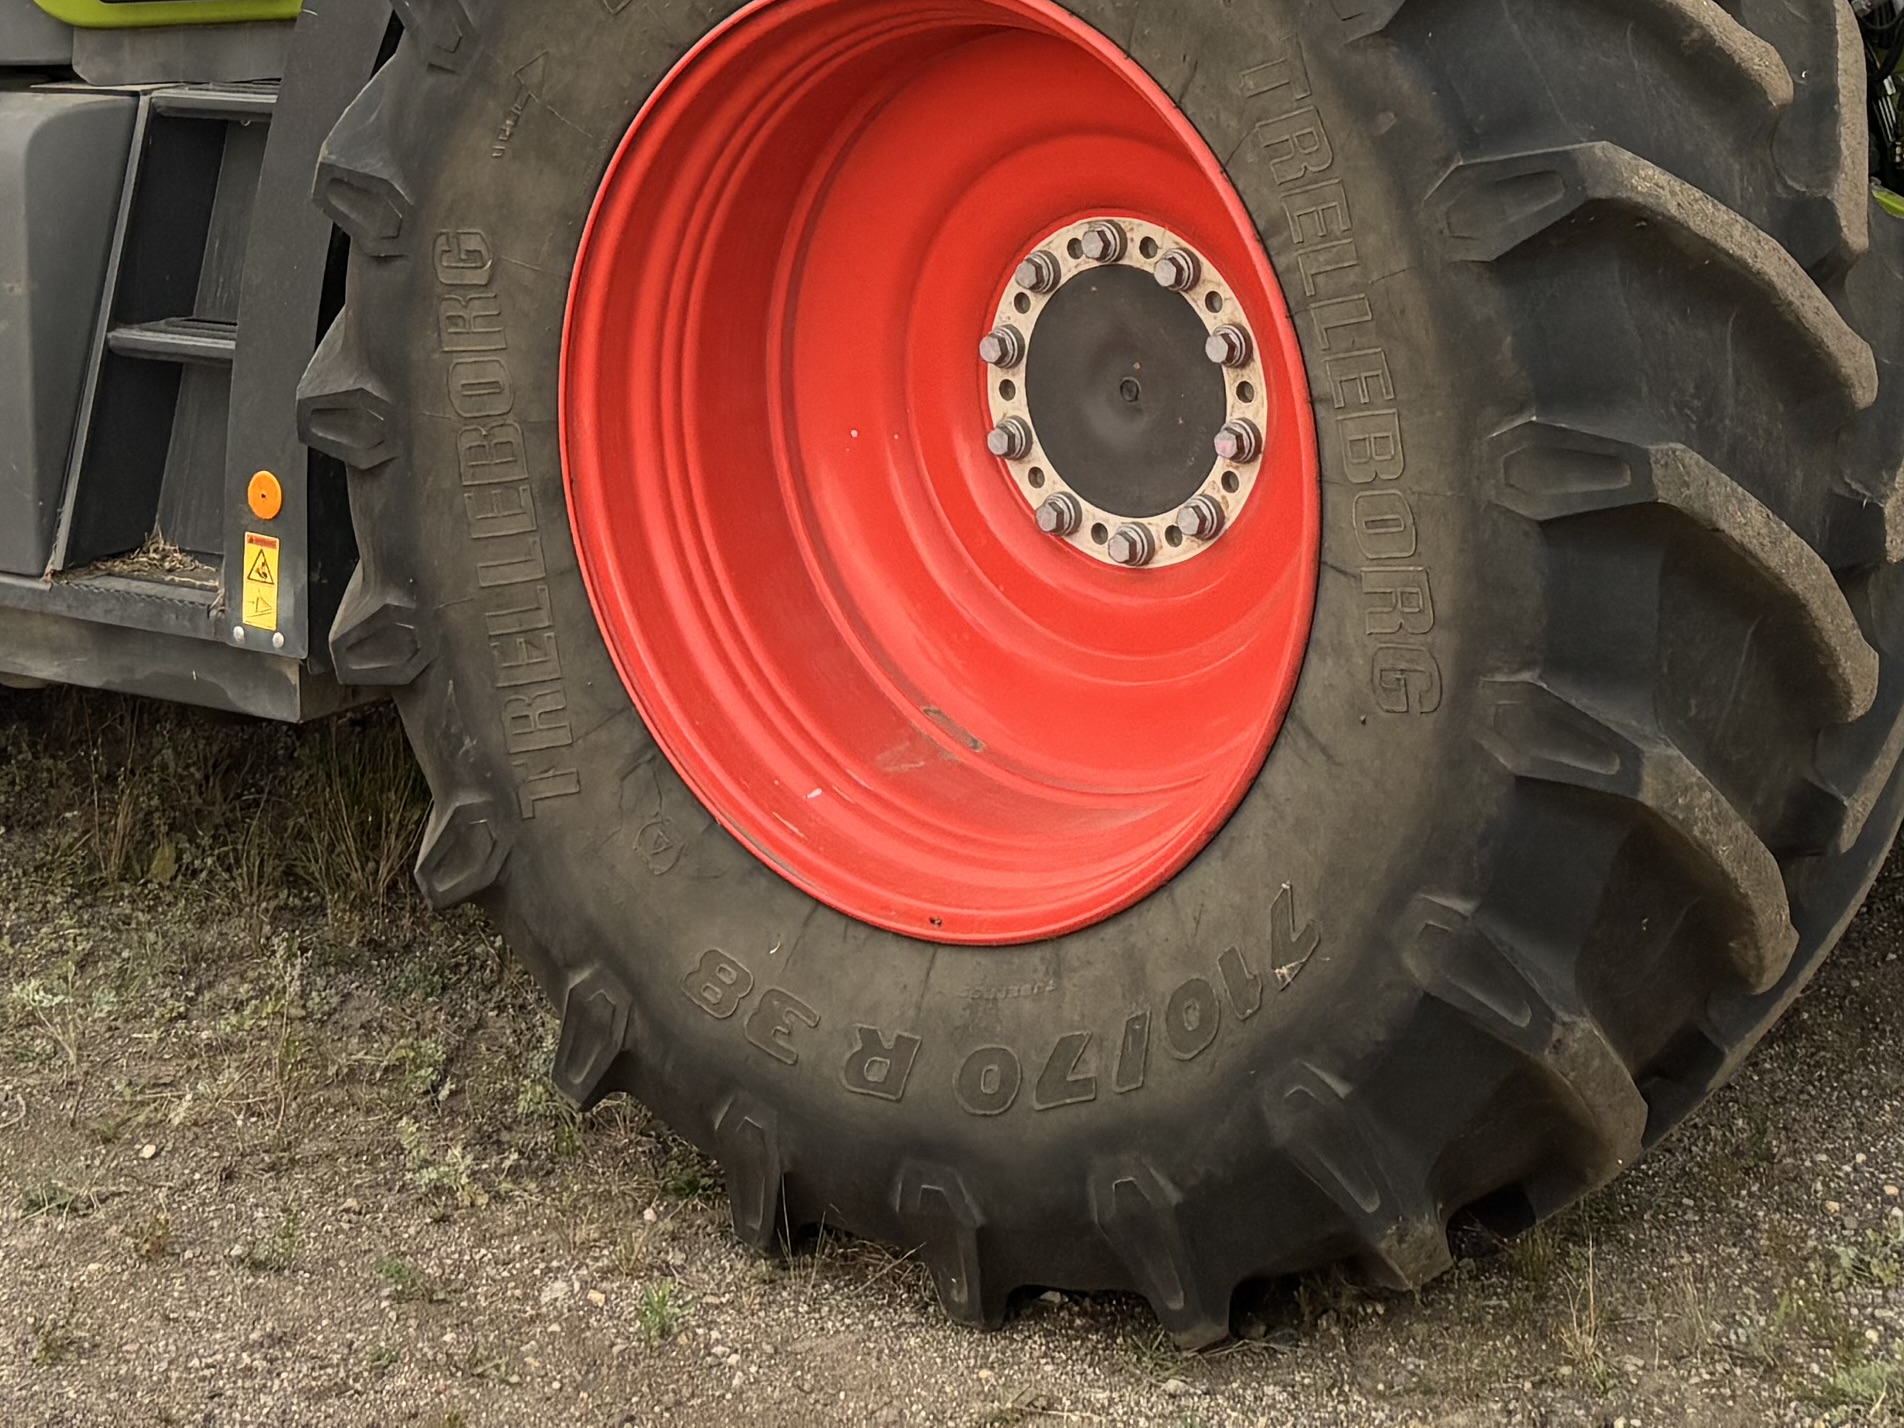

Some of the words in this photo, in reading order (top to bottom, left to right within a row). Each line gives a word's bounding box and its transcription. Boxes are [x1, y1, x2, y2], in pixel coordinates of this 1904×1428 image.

[1238, 32, 1444, 719] TRELLEBORG
[432, 227, 582, 820] TRELLEBORG
[681, 948, 821, 1066] 38
[843, 1024, 921, 1102] R
[954, 882, 1322, 1116] 710/70
